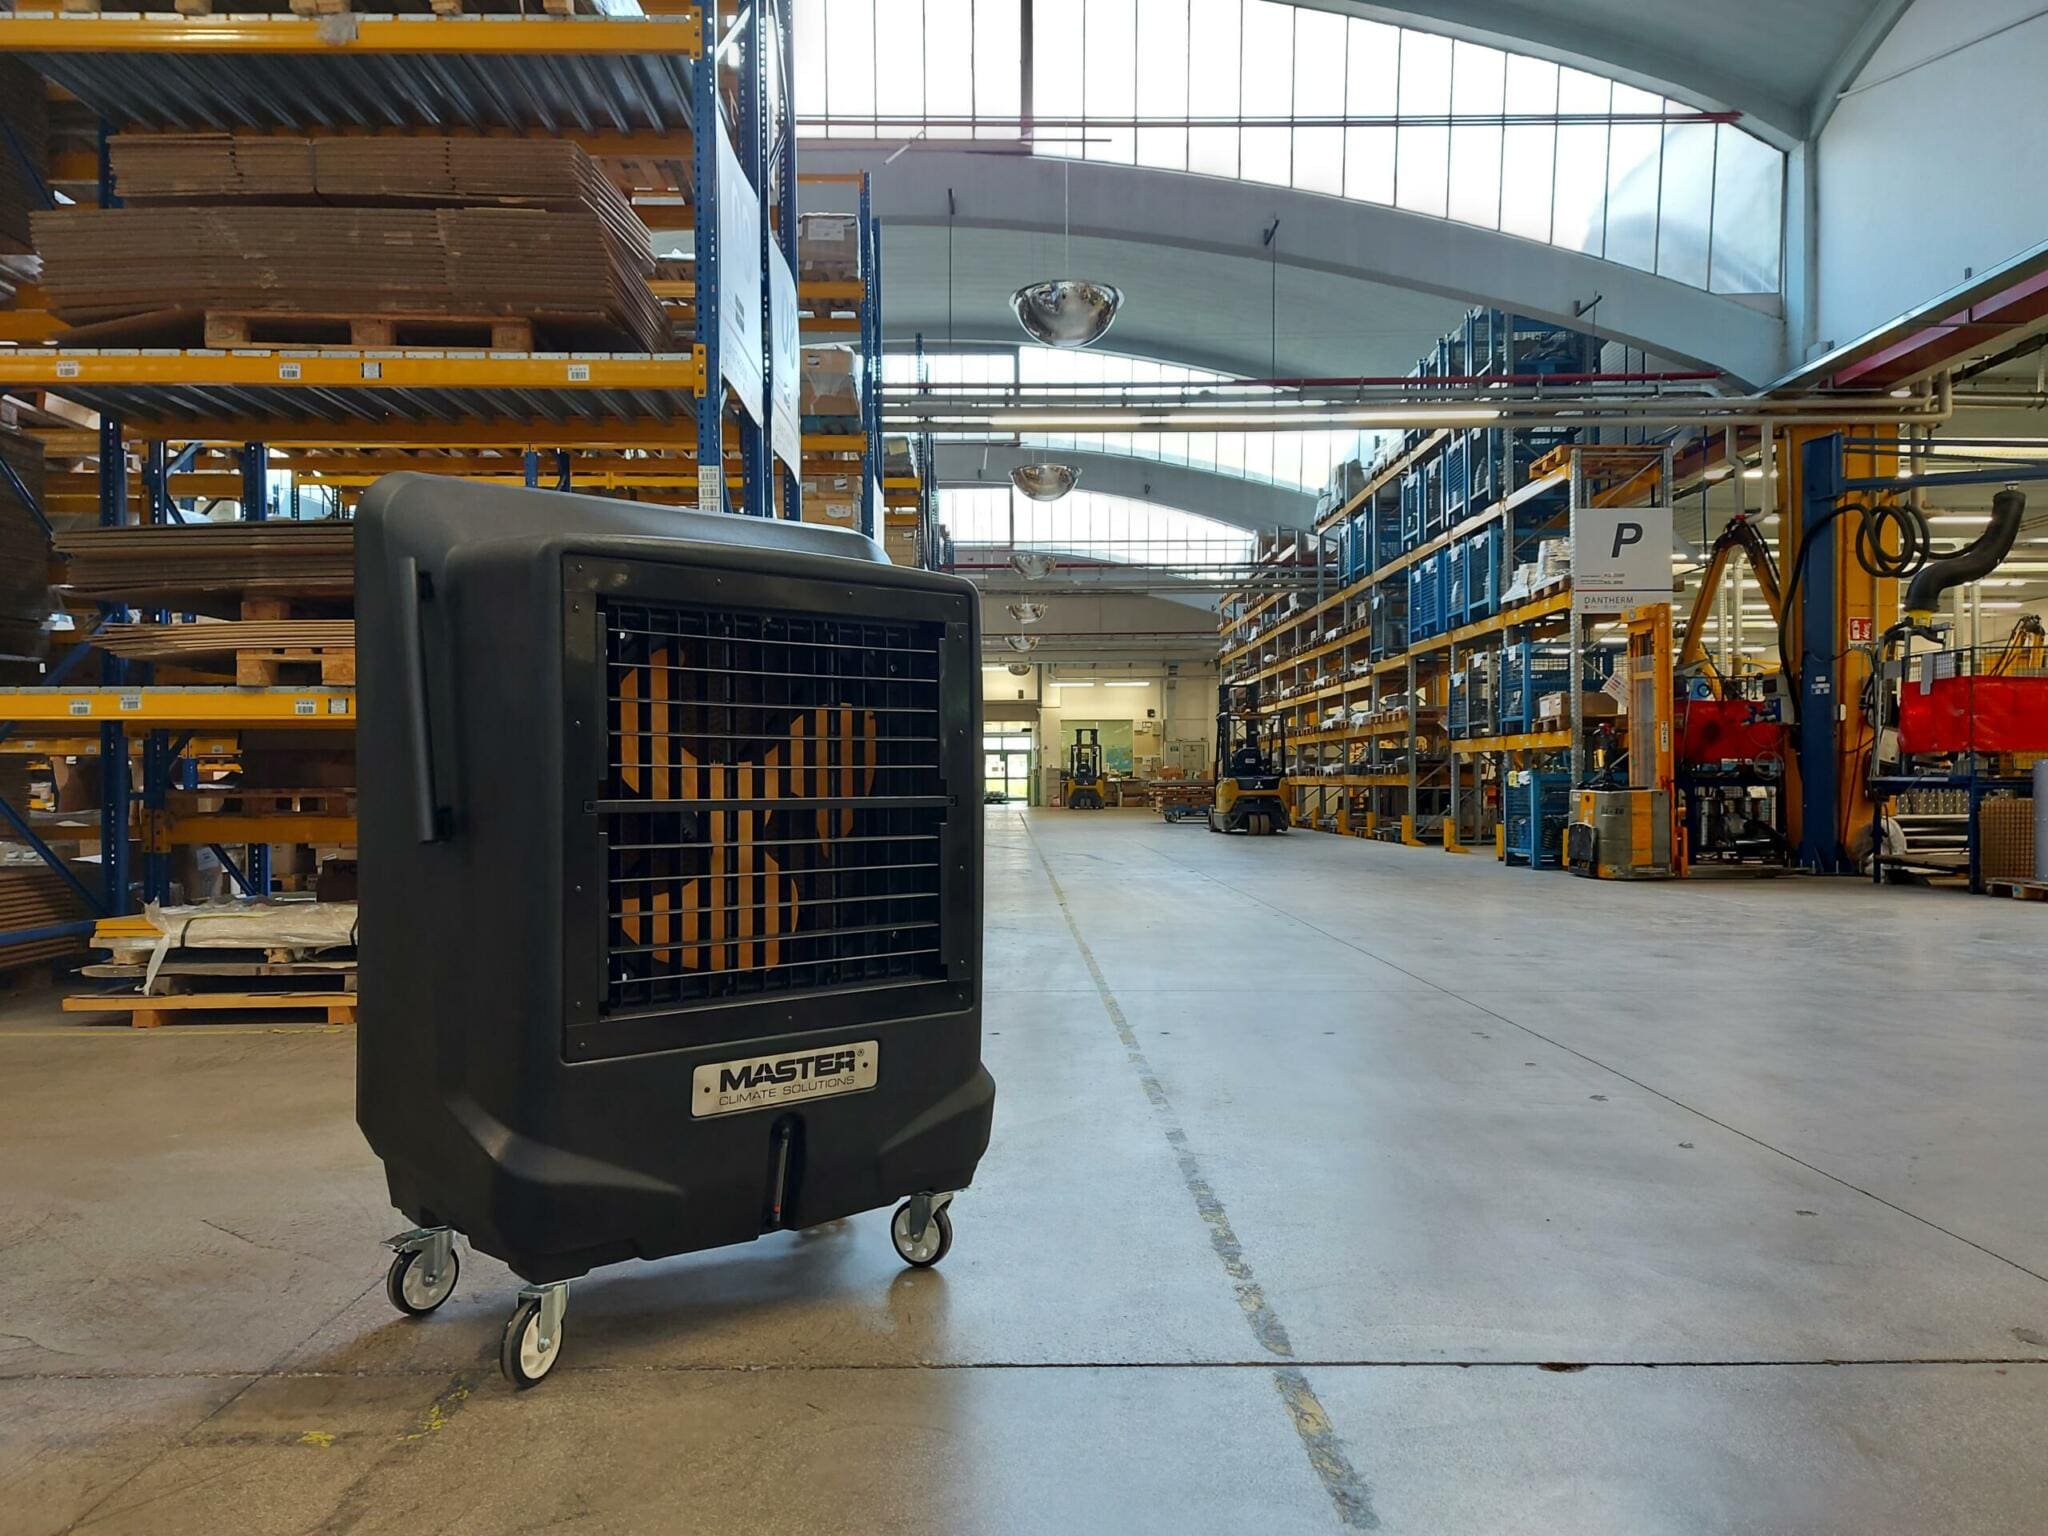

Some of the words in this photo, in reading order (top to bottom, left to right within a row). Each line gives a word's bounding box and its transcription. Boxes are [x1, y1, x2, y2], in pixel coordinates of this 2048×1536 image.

[1611, 523, 1643, 558] P
[1584, 596, 1634, 605] DANTHERM
[719, 1088, 777, 1106] CLIMATE
[782, 1075, 856, 1096] SOLUTIONS
